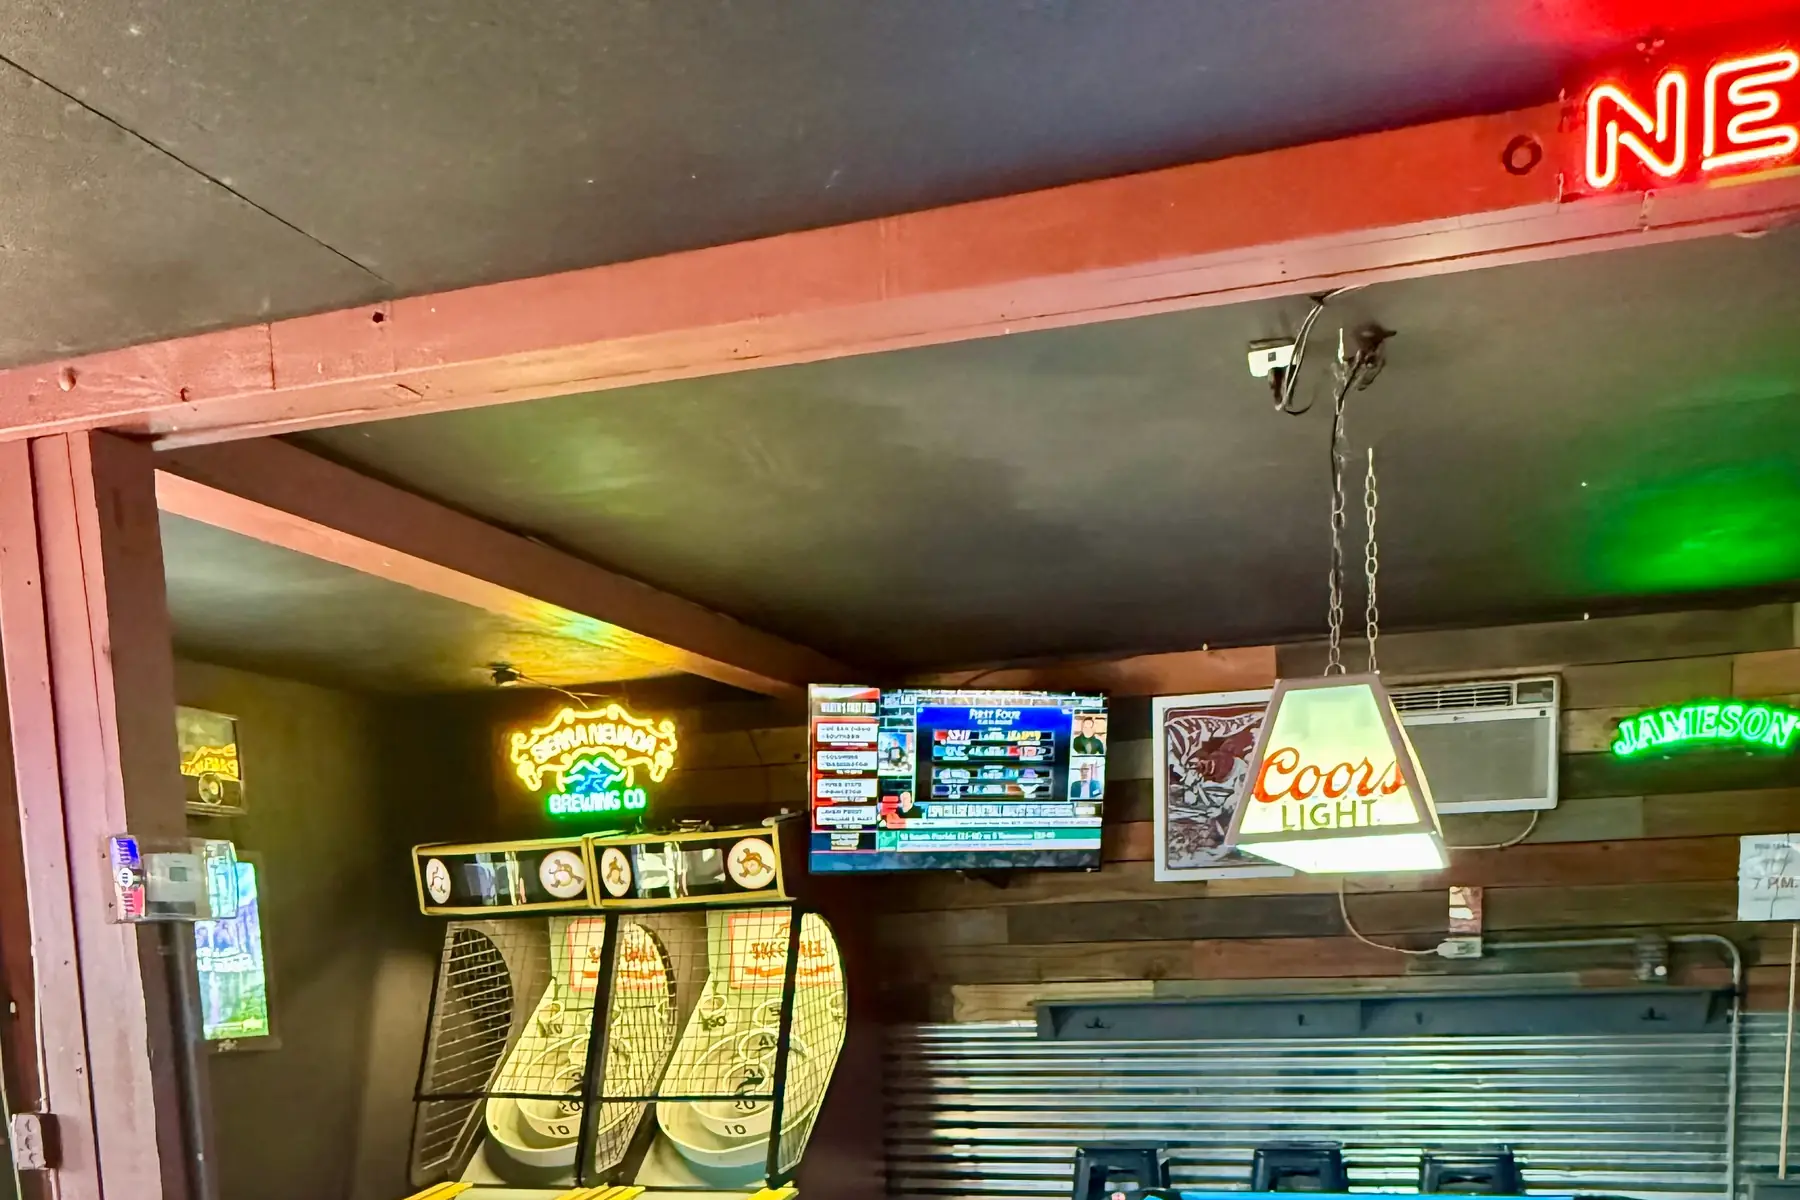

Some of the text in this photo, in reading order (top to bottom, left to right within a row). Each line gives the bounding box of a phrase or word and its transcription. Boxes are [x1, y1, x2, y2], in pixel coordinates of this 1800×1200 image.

[1585, 49, 1800, 188] NE
[995, 709, 1021, 720] FOUR
[1613, 704, 1800, 755] JAMESON
[588, 722, 657, 756] NEVADA
[1252, 747, 1406, 803] Coors
[548, 787, 647, 814] BREWING CO
[1281, 799, 1378, 830] LIGHT
[547, 1124, 570, 1136] 10
[724, 1124, 747, 1136] 10
